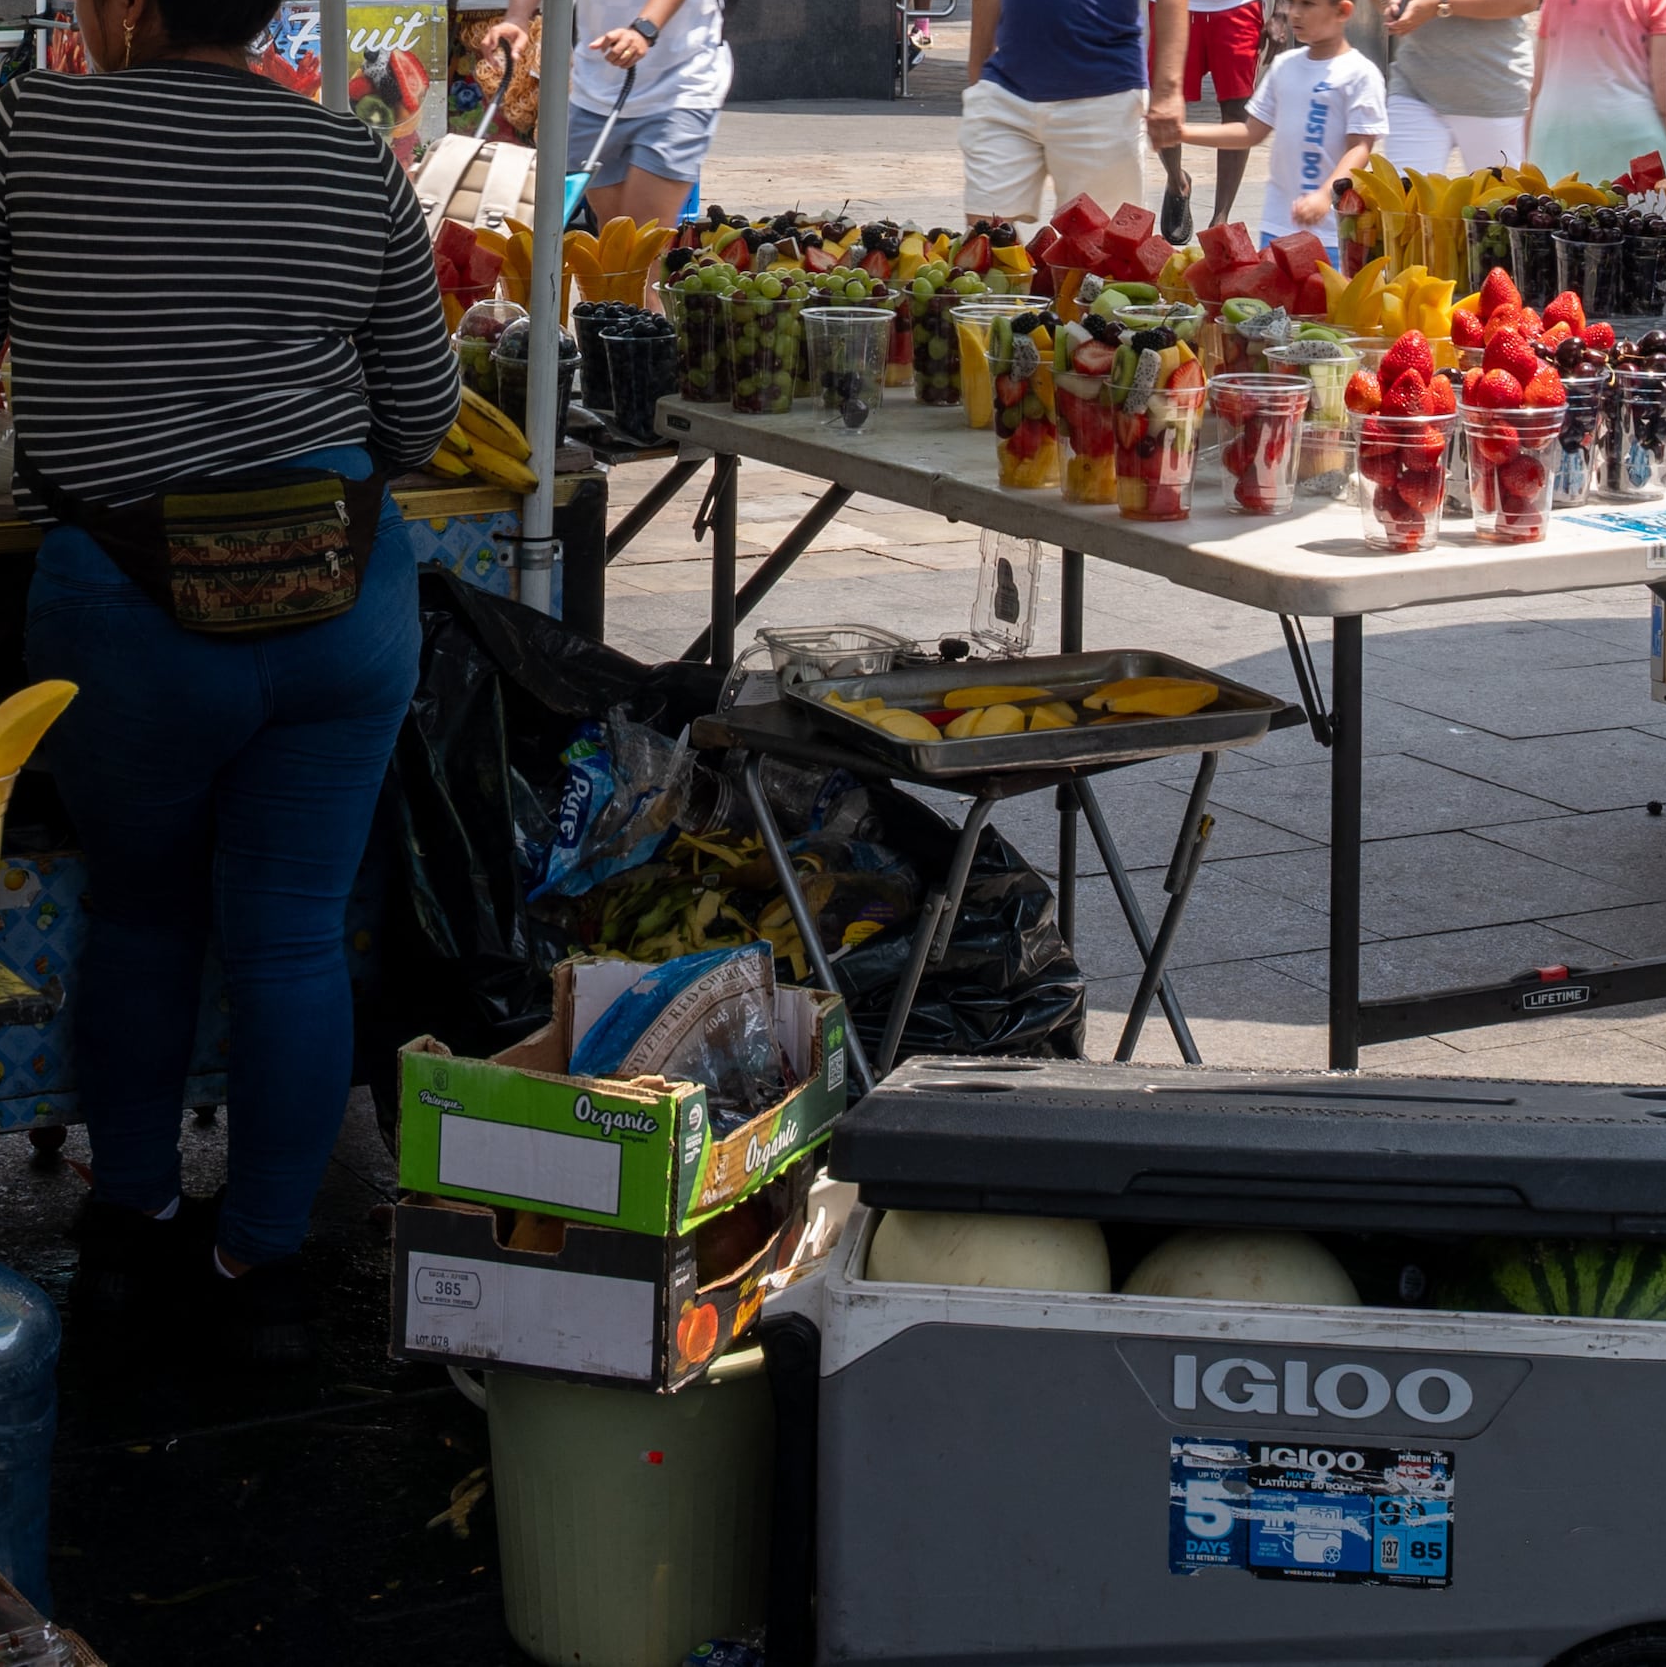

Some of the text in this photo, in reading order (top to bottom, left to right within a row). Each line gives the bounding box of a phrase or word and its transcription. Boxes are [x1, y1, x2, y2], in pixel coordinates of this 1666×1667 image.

[287, 11, 426, 60] Fuit
[1304, 99, 1329, 146] JUST
[1301, 152, 1321, 179] DO
[560, 775, 591, 840] Pure
[1531, 990, 1582, 1005] LIFETIME
[629, 1020, 669, 1074] SWEET
[669, 992, 699, 1021] RED
[704, 1009, 730, 1034] 4045
[574, 1094, 658, 1133] Organic
[745, 1119, 799, 1176] Organic
[435, 1281, 461, 1295] 365
[416, 1334, 429, 1344] LOT
[1174, 1354, 1473, 1423] IGLOO
[1260, 1446, 1365, 1472] IGLOO
[1433, 1456, 1448, 1464] THE
[1259, 1479, 1305, 1489] LATITUDE
[1185, 1480, 1233, 1539] 5
[1186, 1541, 1230, 1554] DAYS
[1382, 1541, 1398, 1557] 137
[1410, 1541, 1442, 1560] 85
